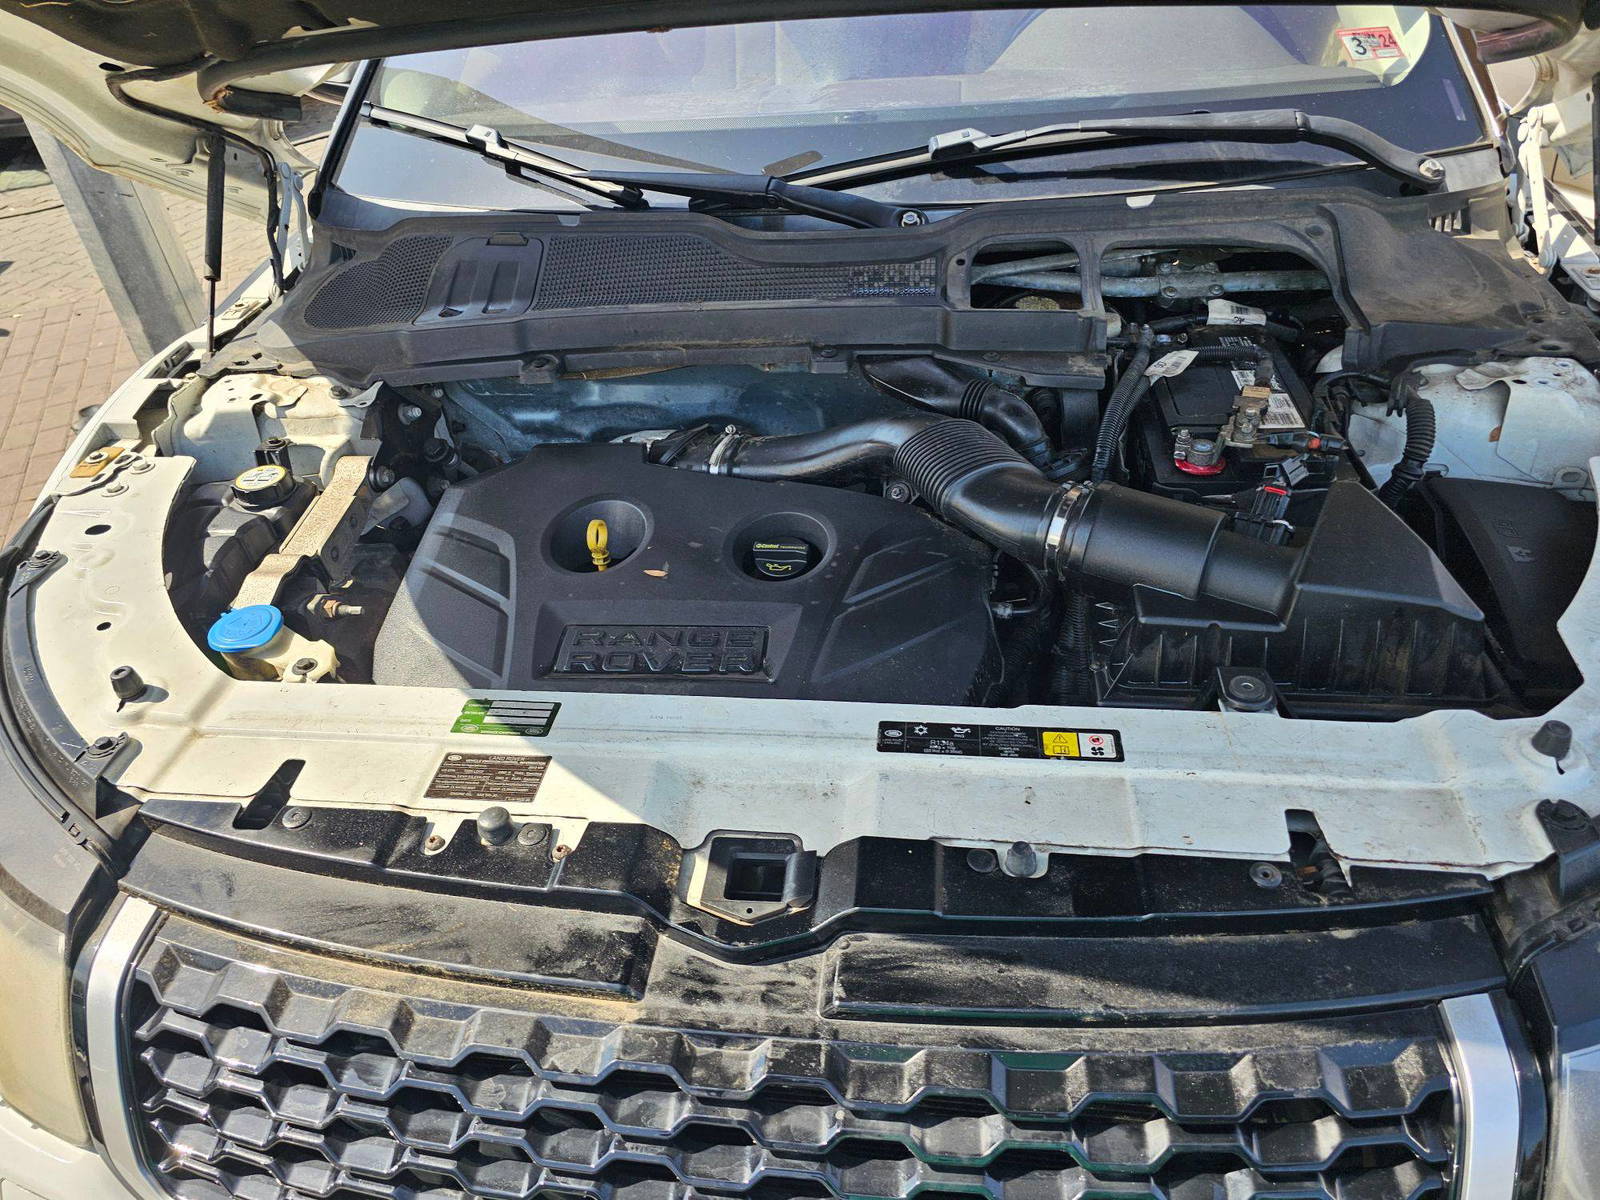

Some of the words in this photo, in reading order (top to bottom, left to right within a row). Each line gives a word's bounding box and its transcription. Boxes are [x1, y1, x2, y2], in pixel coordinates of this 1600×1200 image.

[1351, 36, 1367, 55] 3
[1378, 33, 1398, 48] 24
[571, 630, 757, 648] RANGE
[563, 651, 755, 673] ROVER
